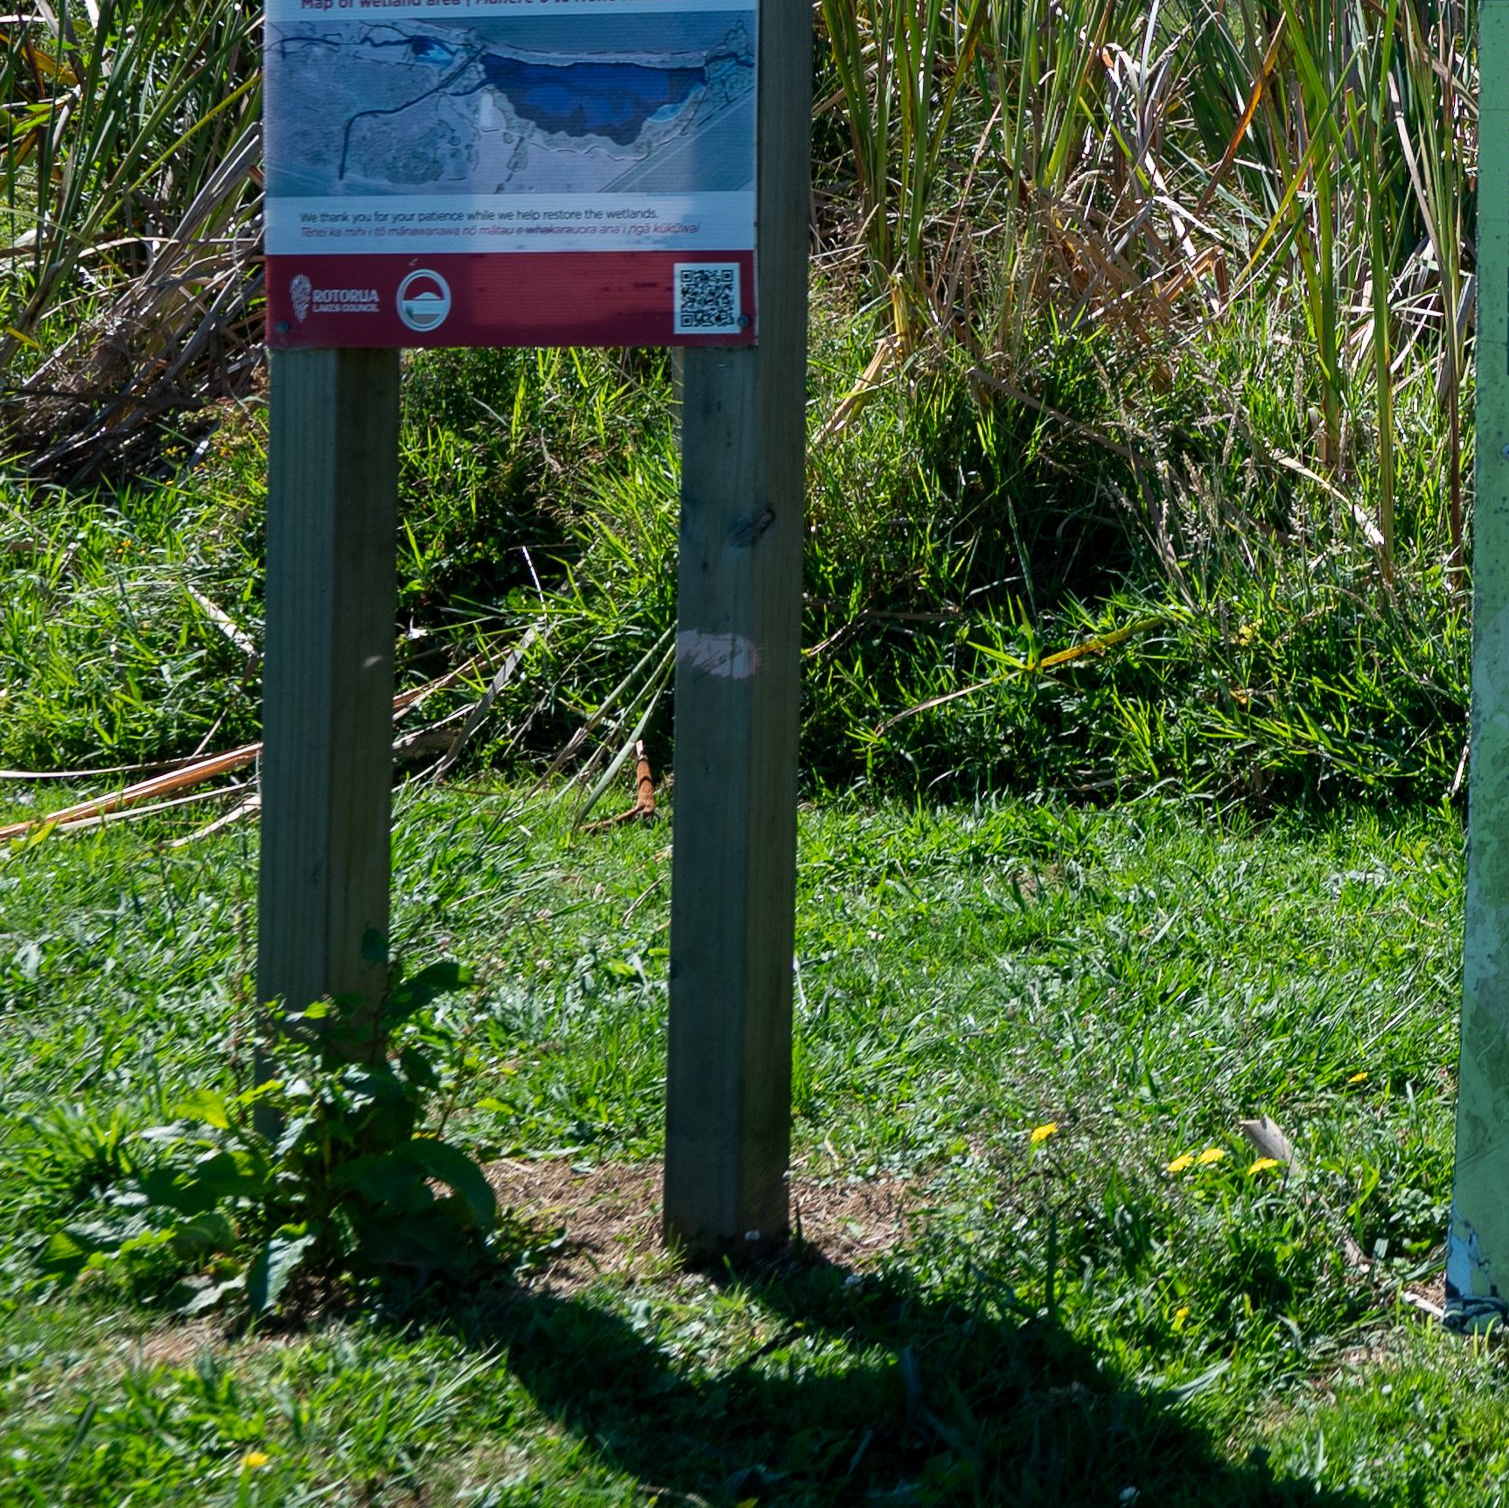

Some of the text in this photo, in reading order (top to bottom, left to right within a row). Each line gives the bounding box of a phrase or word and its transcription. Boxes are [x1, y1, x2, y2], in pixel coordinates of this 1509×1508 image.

[352, 213, 372, 223] you
[373, 210, 389, 221] for
[391, 212, 415, 223] your
[417, 210, 465, 223] patience
[466, 209, 495, 220] while
[497, 212, 514, 220] we
[515, 209, 541, 222] help
[542, 209, 582, 220] restore
[583, 209, 603, 219] the
[605, 208, 659, 219] wetlands.
[312, 289, 379, 302] ROTORUA
